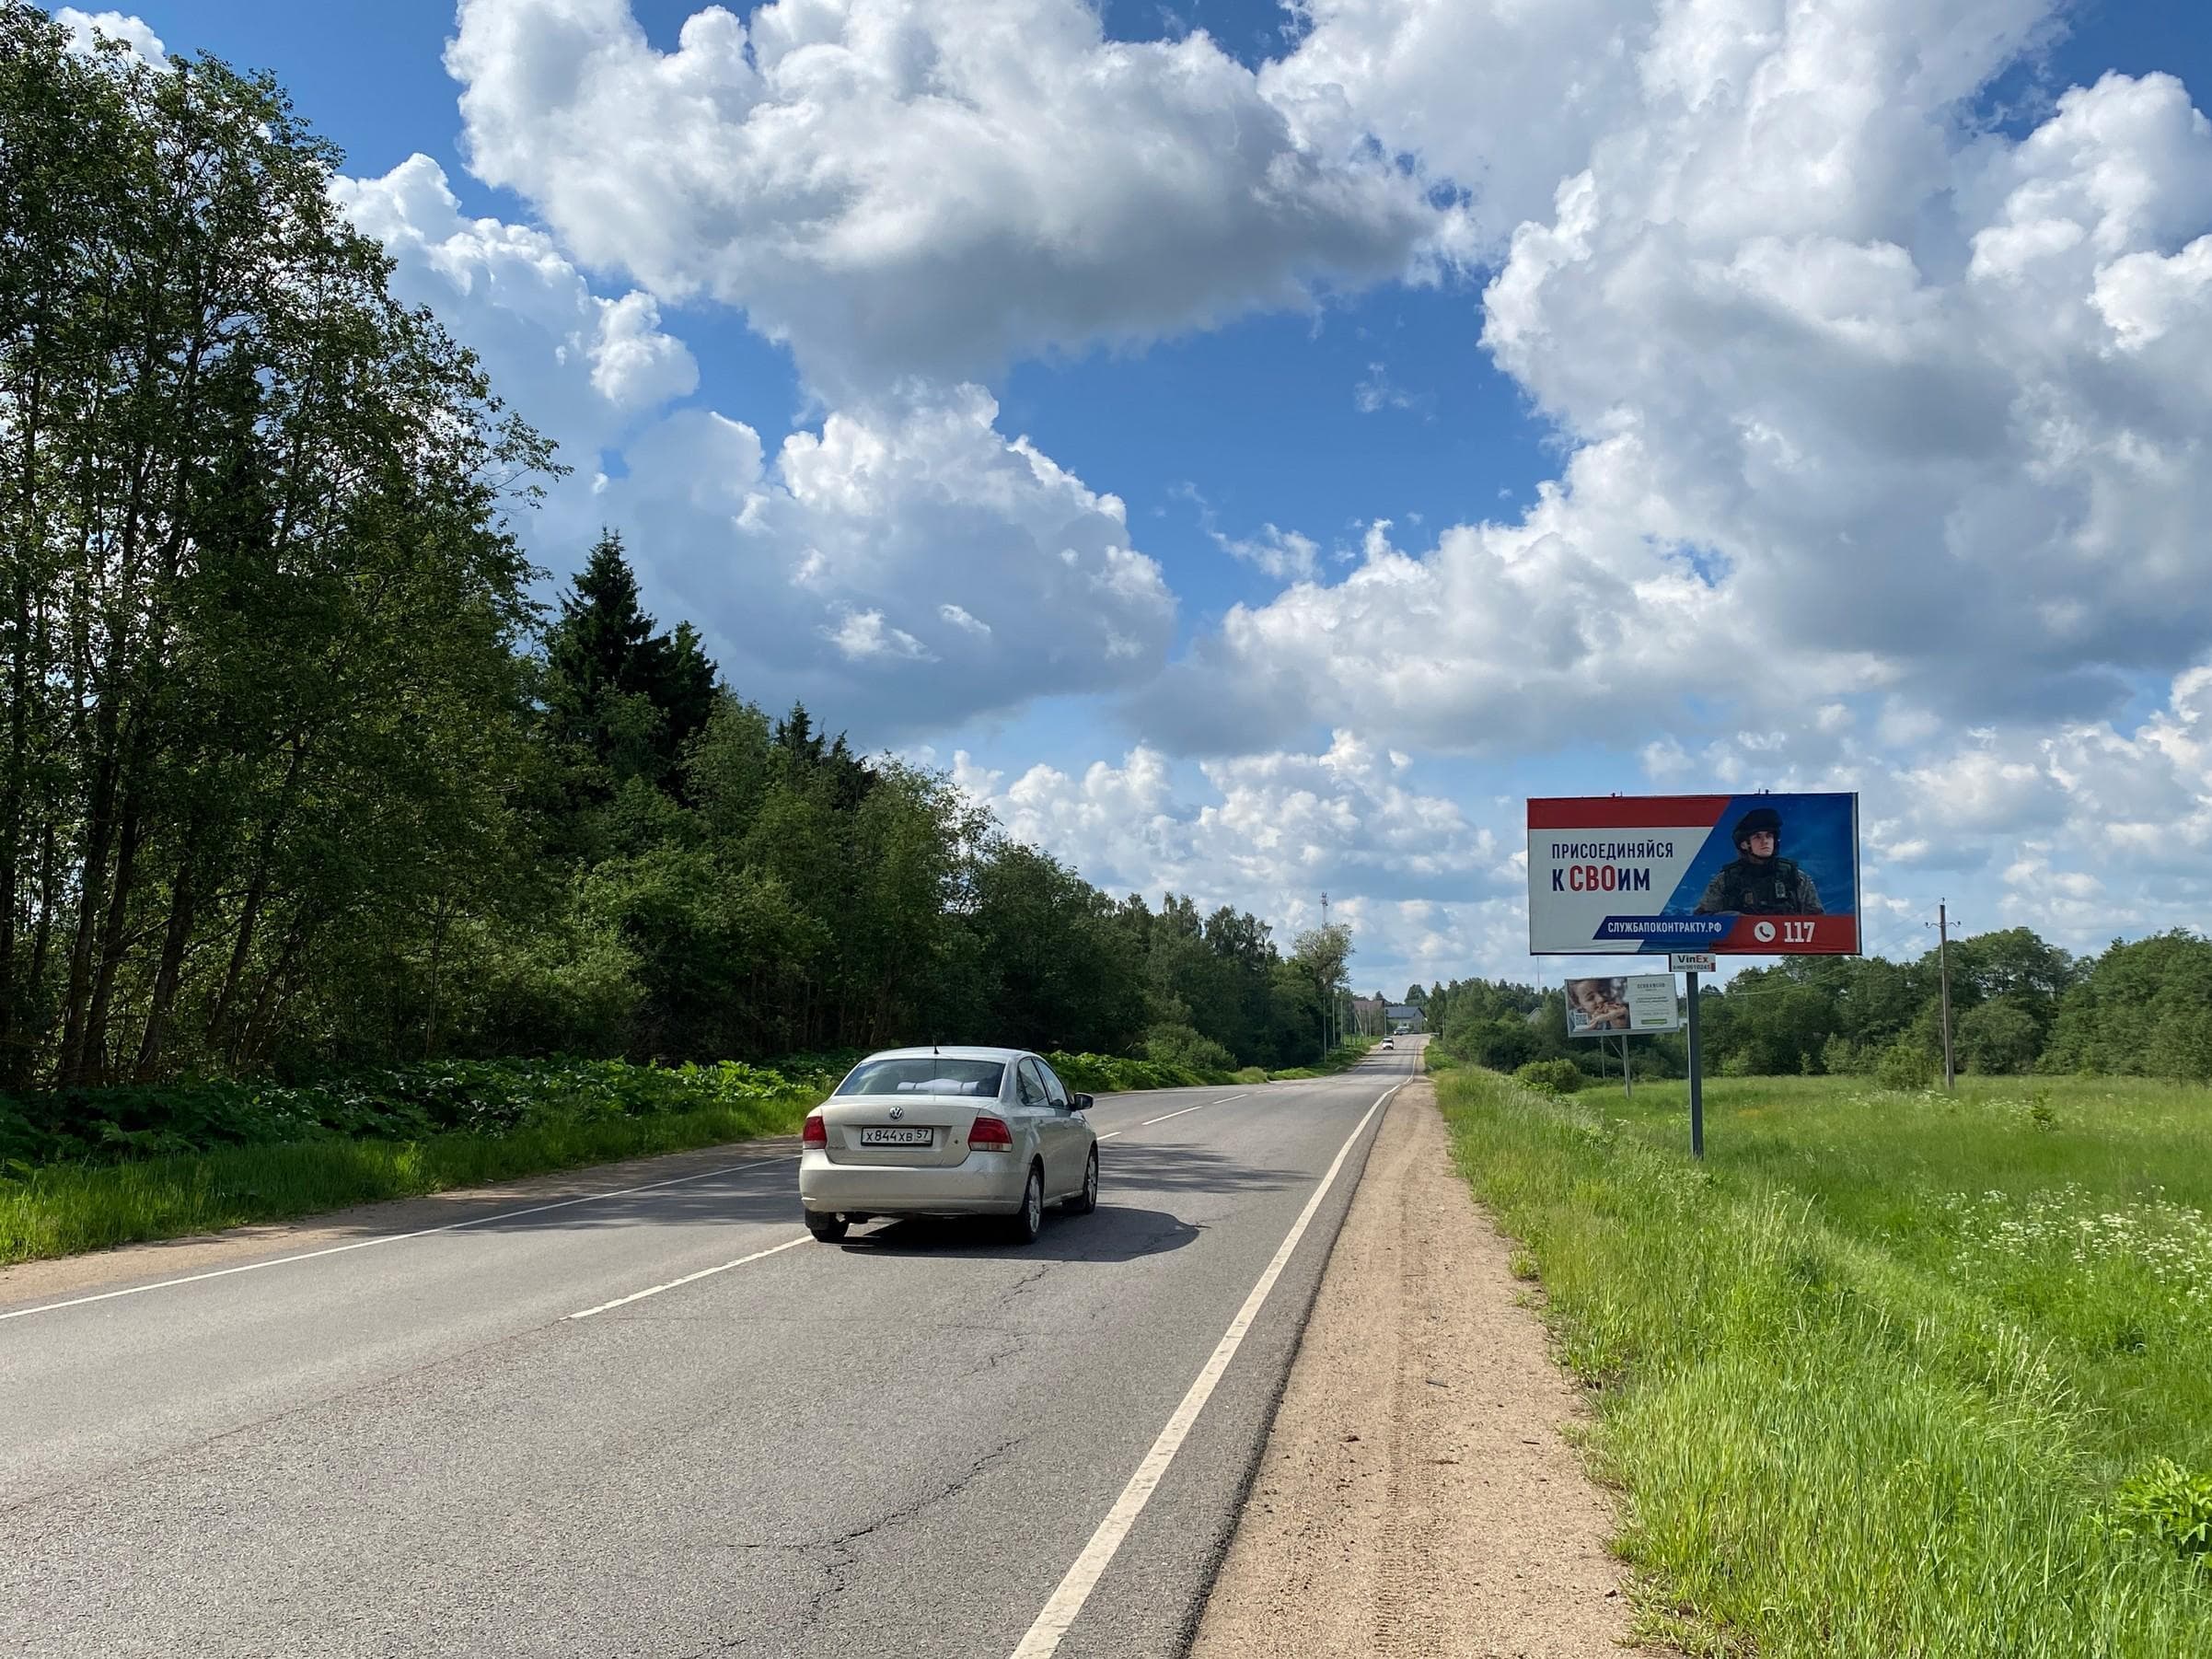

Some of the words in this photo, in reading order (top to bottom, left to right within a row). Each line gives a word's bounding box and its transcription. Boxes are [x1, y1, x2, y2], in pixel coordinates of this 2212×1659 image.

[1552, 840, 1673, 860] ПРИСОЕДИНЯЙСЯ
[1552, 869, 1565, 891] К
[1607, 922, 1722, 933] СЛУЖБАПОКОНТРАКТУ.РФ
[1784, 922, 1815, 943] 117
[1677, 955, 1708, 963] VinEx
